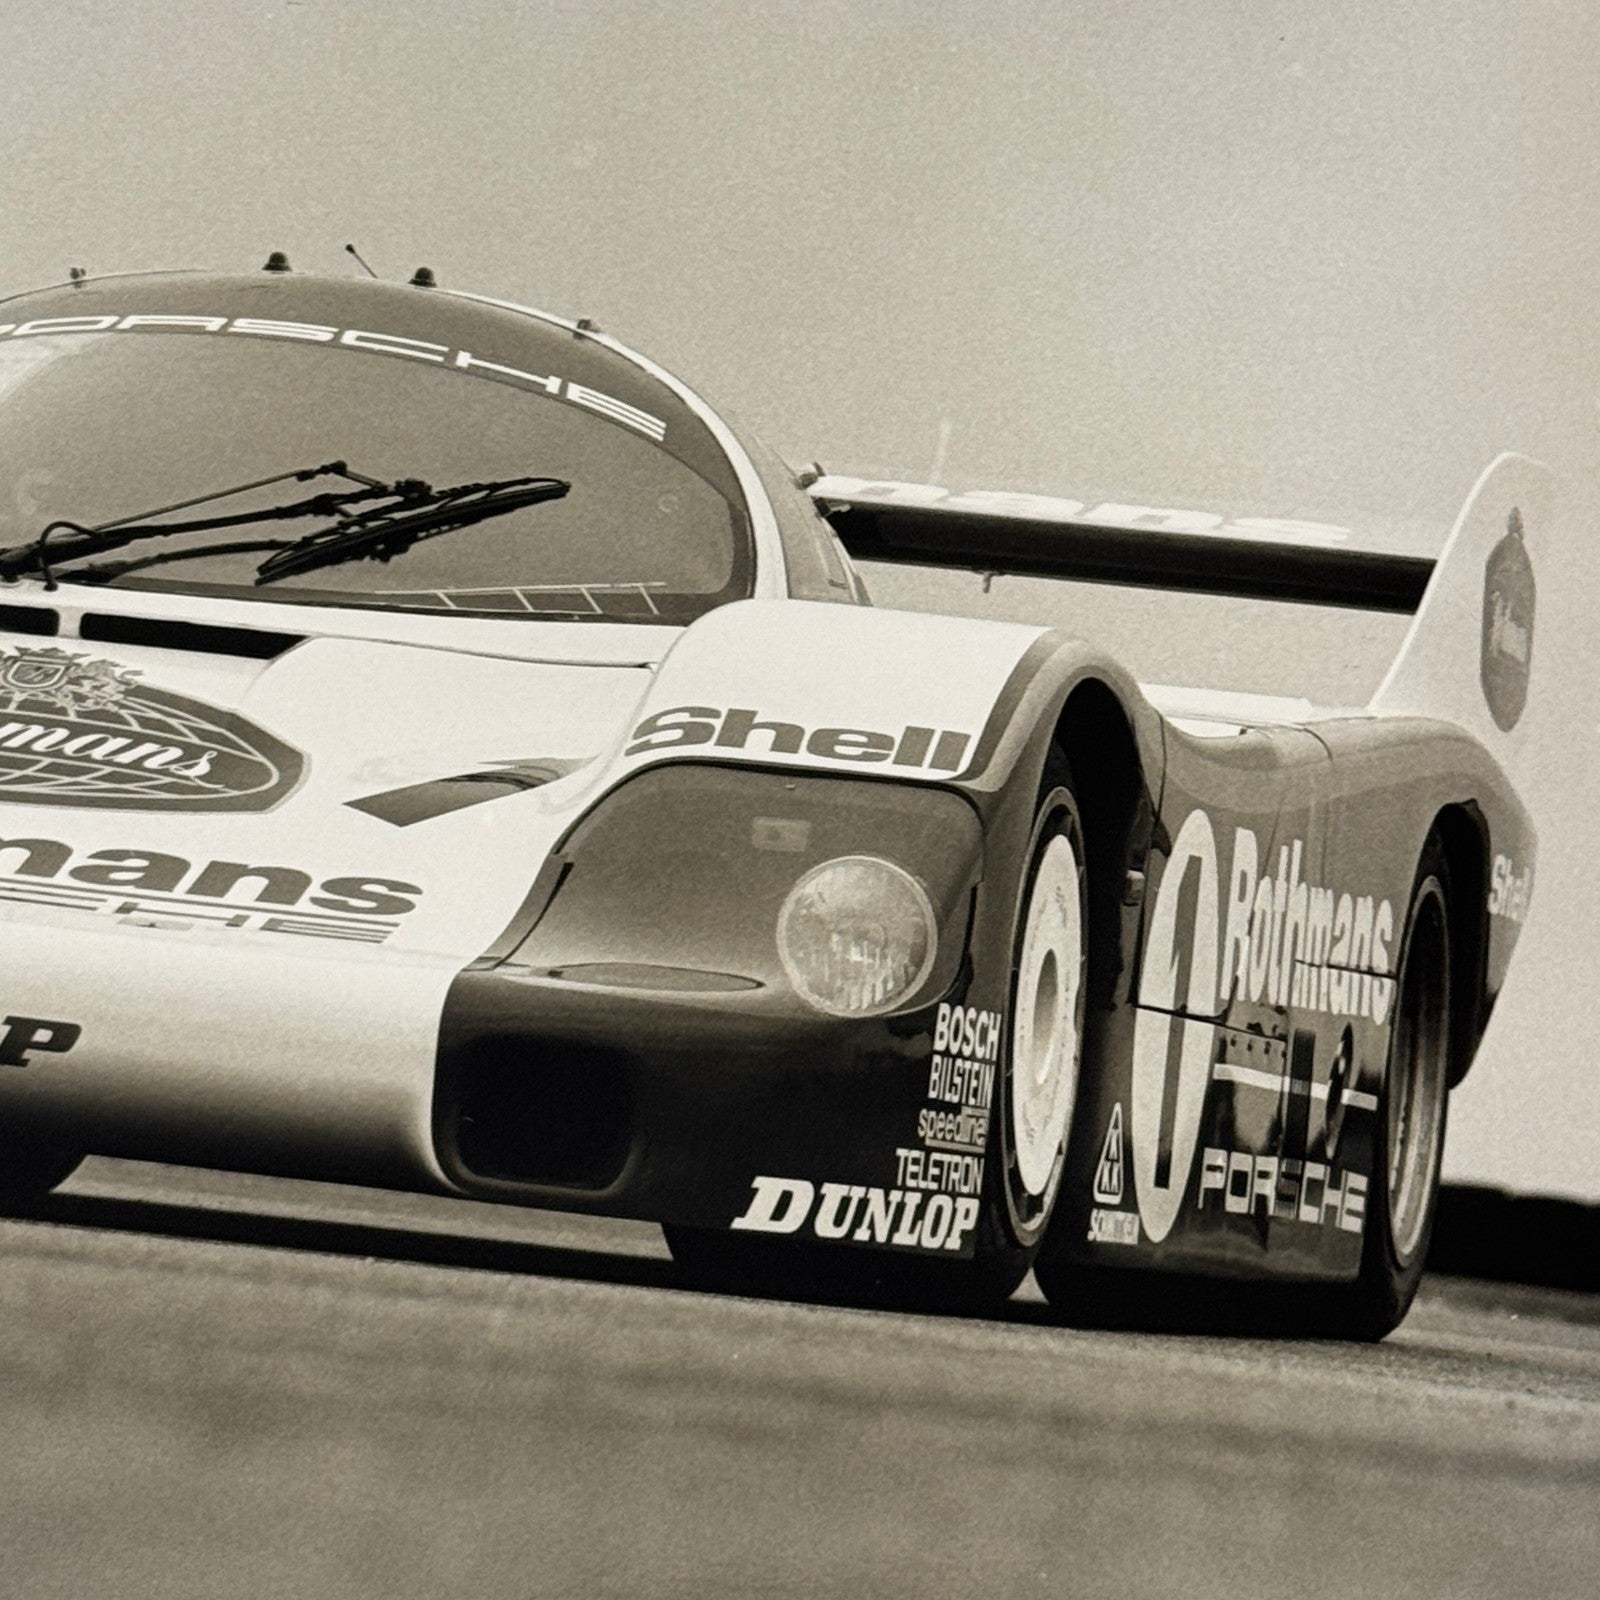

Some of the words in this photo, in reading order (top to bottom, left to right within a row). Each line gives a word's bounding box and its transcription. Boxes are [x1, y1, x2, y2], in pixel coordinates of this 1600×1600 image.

[0, 315, 666, 441] ORSCHE
[624, 705, 972, 773] Shell
[1220, 826, 1394, 1026] Rothmans
[0, 1015, 82, 1067] P
[933, 1002, 1002, 1062] BOSCH
[927, 1053, 997, 1111] BILSTEIN
[895, 1148, 985, 1196] TELETRON
[1198, 1147, 1369, 1233] PORSCHE
[730, 1175, 981, 1251] DUNLOP
